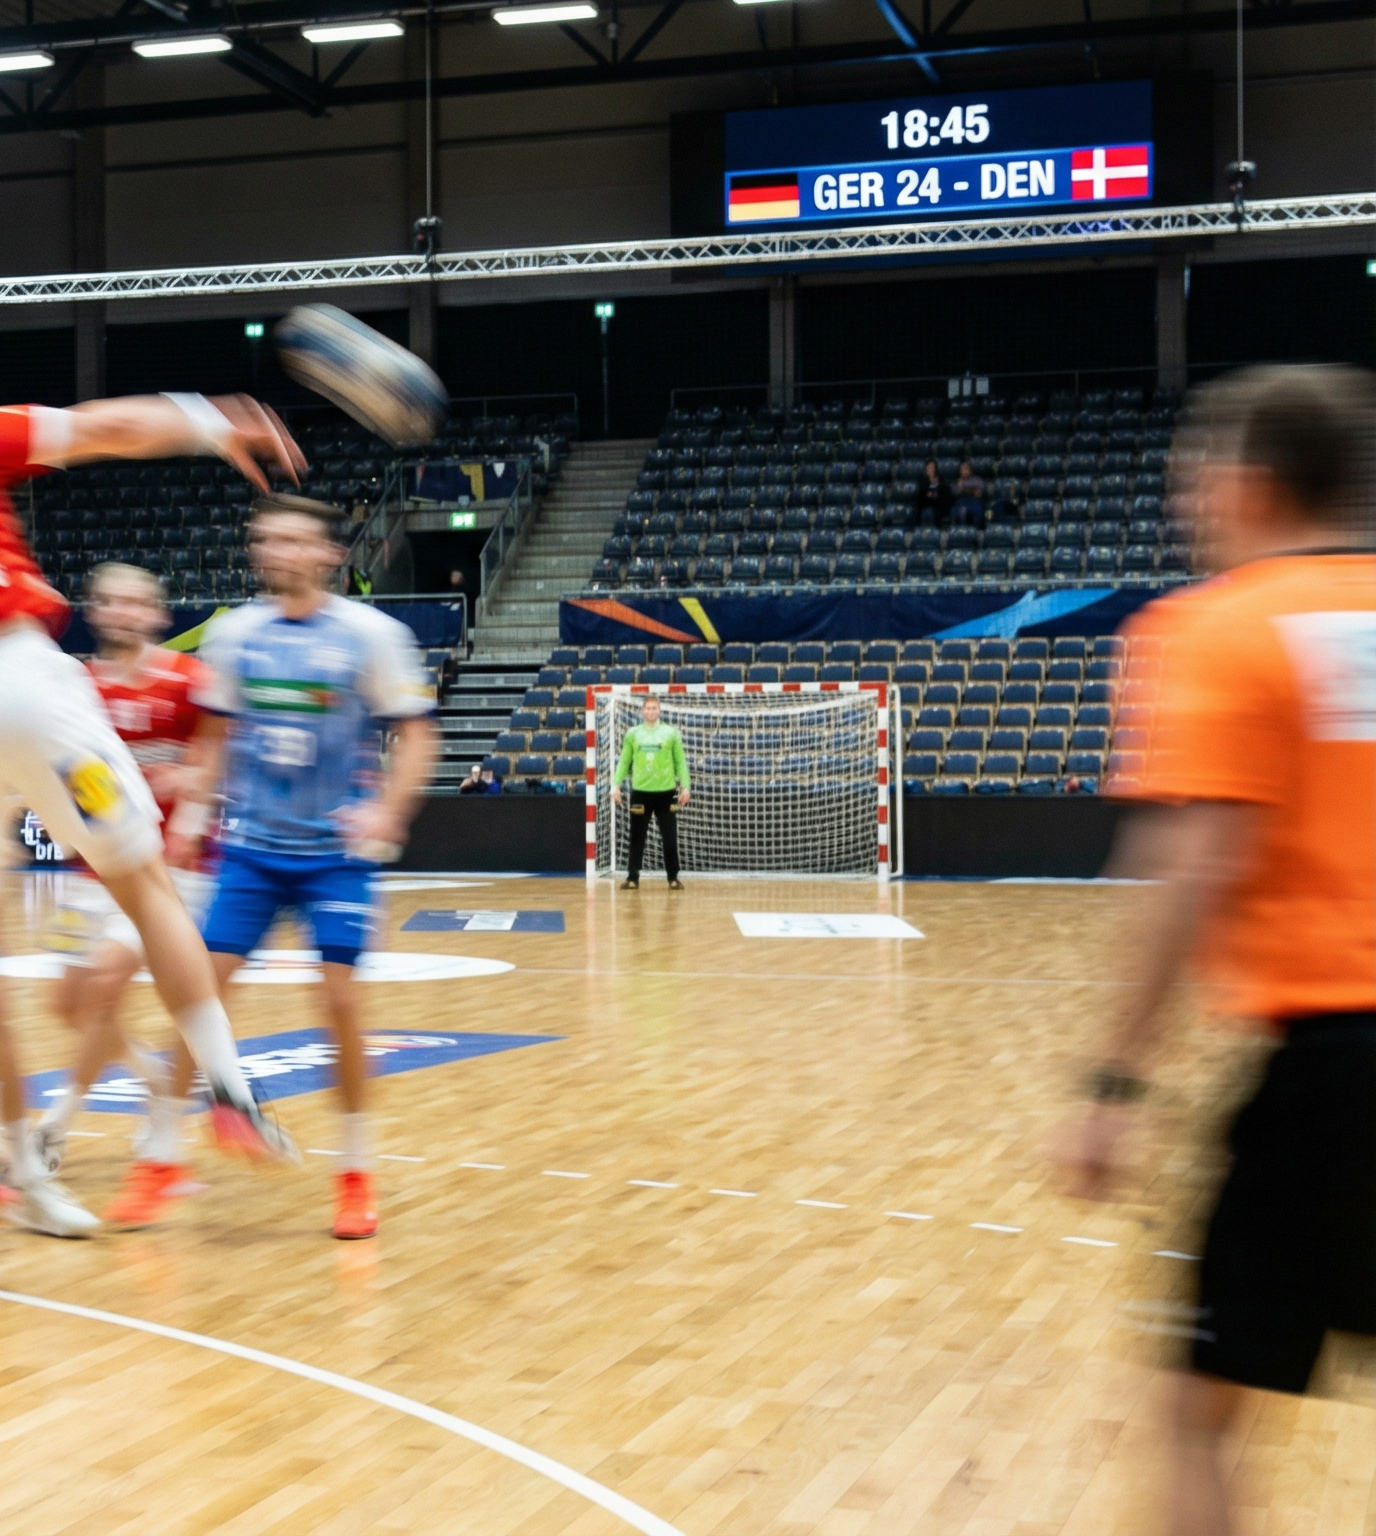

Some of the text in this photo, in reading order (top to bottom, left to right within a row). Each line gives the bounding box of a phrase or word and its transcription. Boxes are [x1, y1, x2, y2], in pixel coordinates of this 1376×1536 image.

[880, 104, 990, 149] 18:45
[813, 159, 1055, 211] GER 24 - DEN
